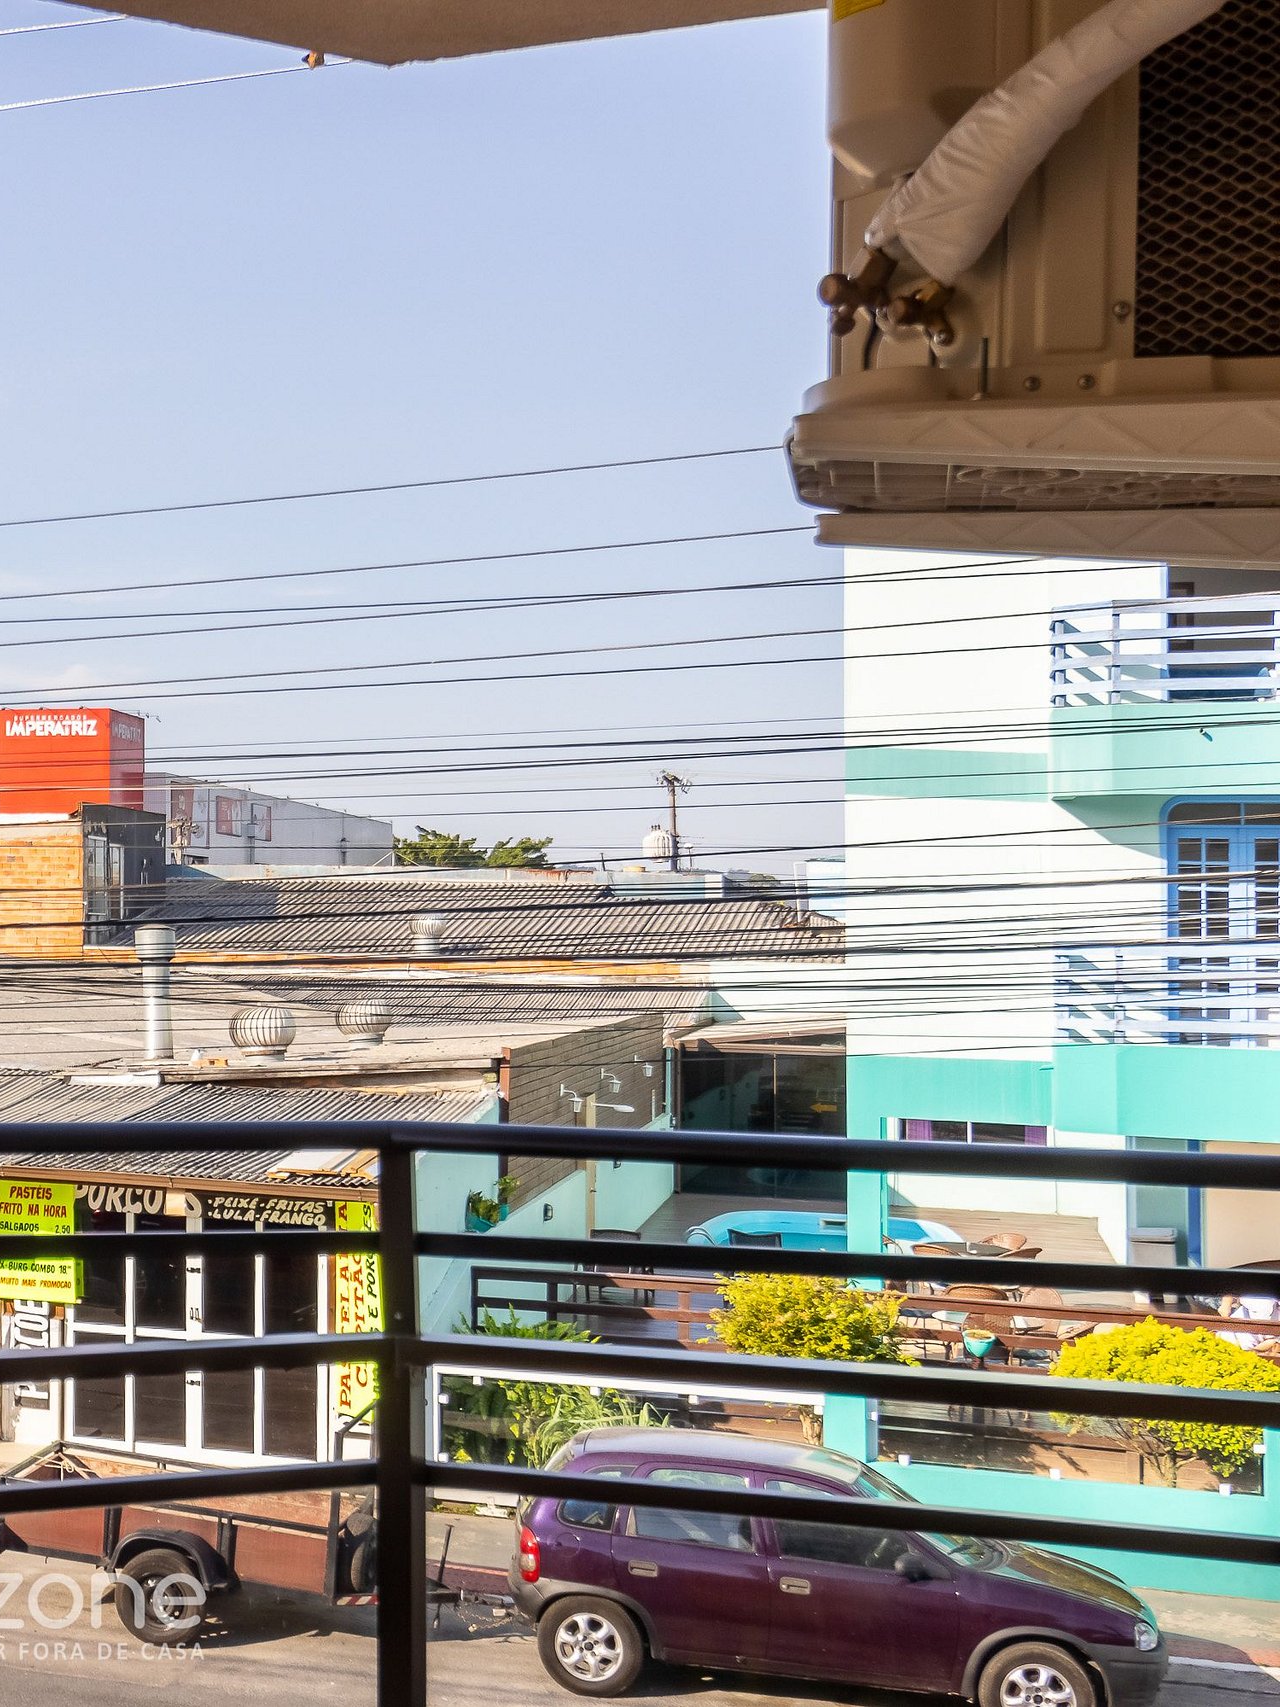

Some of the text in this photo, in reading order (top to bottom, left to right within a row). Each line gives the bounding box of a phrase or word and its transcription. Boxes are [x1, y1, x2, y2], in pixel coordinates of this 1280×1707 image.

[5, 720, 98, 737] IMPERATRIZ
[9, 1185, 53, 1200] PASTÉIS
[0, 1202, 67, 1218] FRITO NA HORA
[0, 1220, 40, 1232] SALGADOS
[31, 1263, 56, 1274] COMBO
[22, 1278, 37, 1287] MAIS
